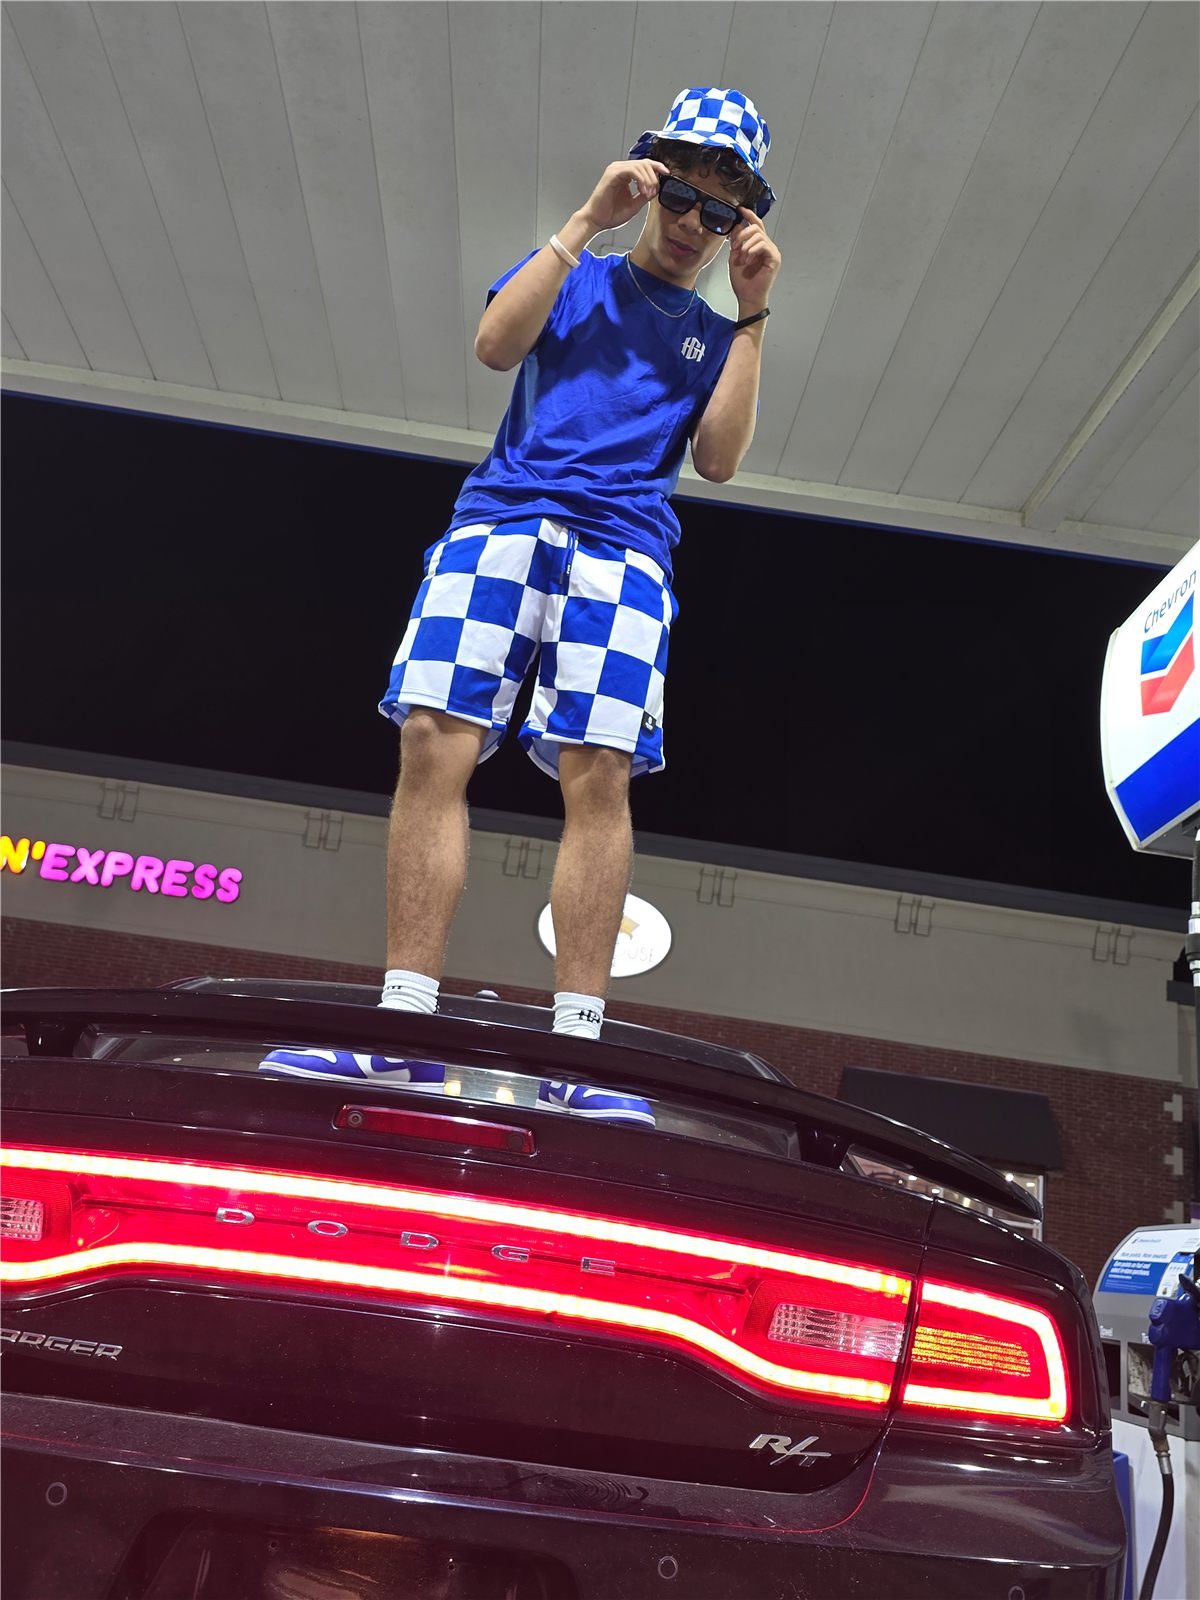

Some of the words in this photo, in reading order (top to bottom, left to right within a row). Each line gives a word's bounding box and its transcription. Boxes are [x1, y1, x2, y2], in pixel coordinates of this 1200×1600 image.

[1143, 569, 1197, 634] Chevron
[39, 843, 244, 903] EXPRESS
[214, 1207, 617, 1277] DODGE
[748, 1433, 833, 1469] R/T
